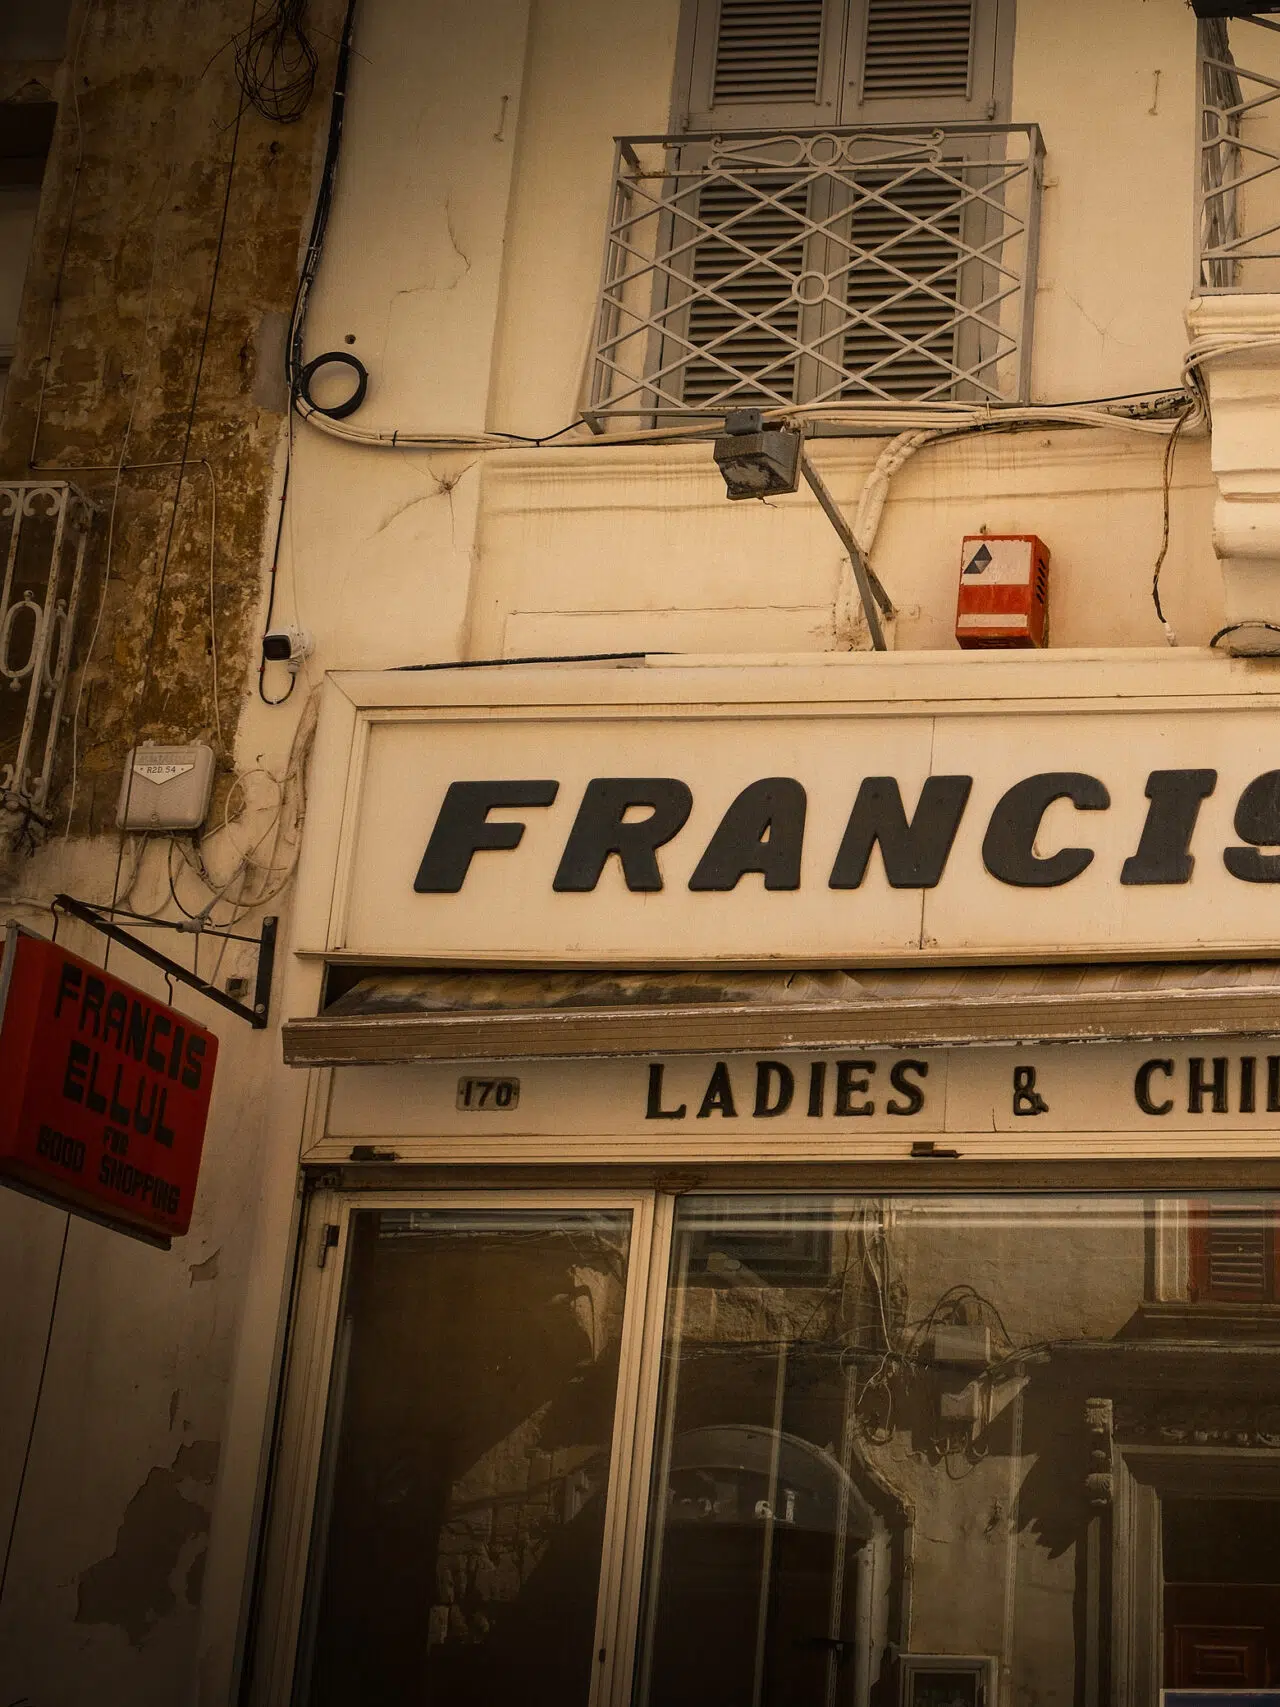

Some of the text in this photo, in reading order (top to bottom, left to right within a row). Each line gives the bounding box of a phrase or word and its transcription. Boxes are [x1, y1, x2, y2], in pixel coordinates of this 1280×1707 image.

[55, 962, 207, 1090] FRANCIS
[63, 1040, 174, 1149] ELLUL
[463, 1080, 512, 1107] 170
[645, 1059, 929, 1120] LADIES
[1013, 1065, 1050, 1117] &
[37, 1124, 181, 1215] GOOD SHOPPING
[103, 1125, 129, 1157] FOR
